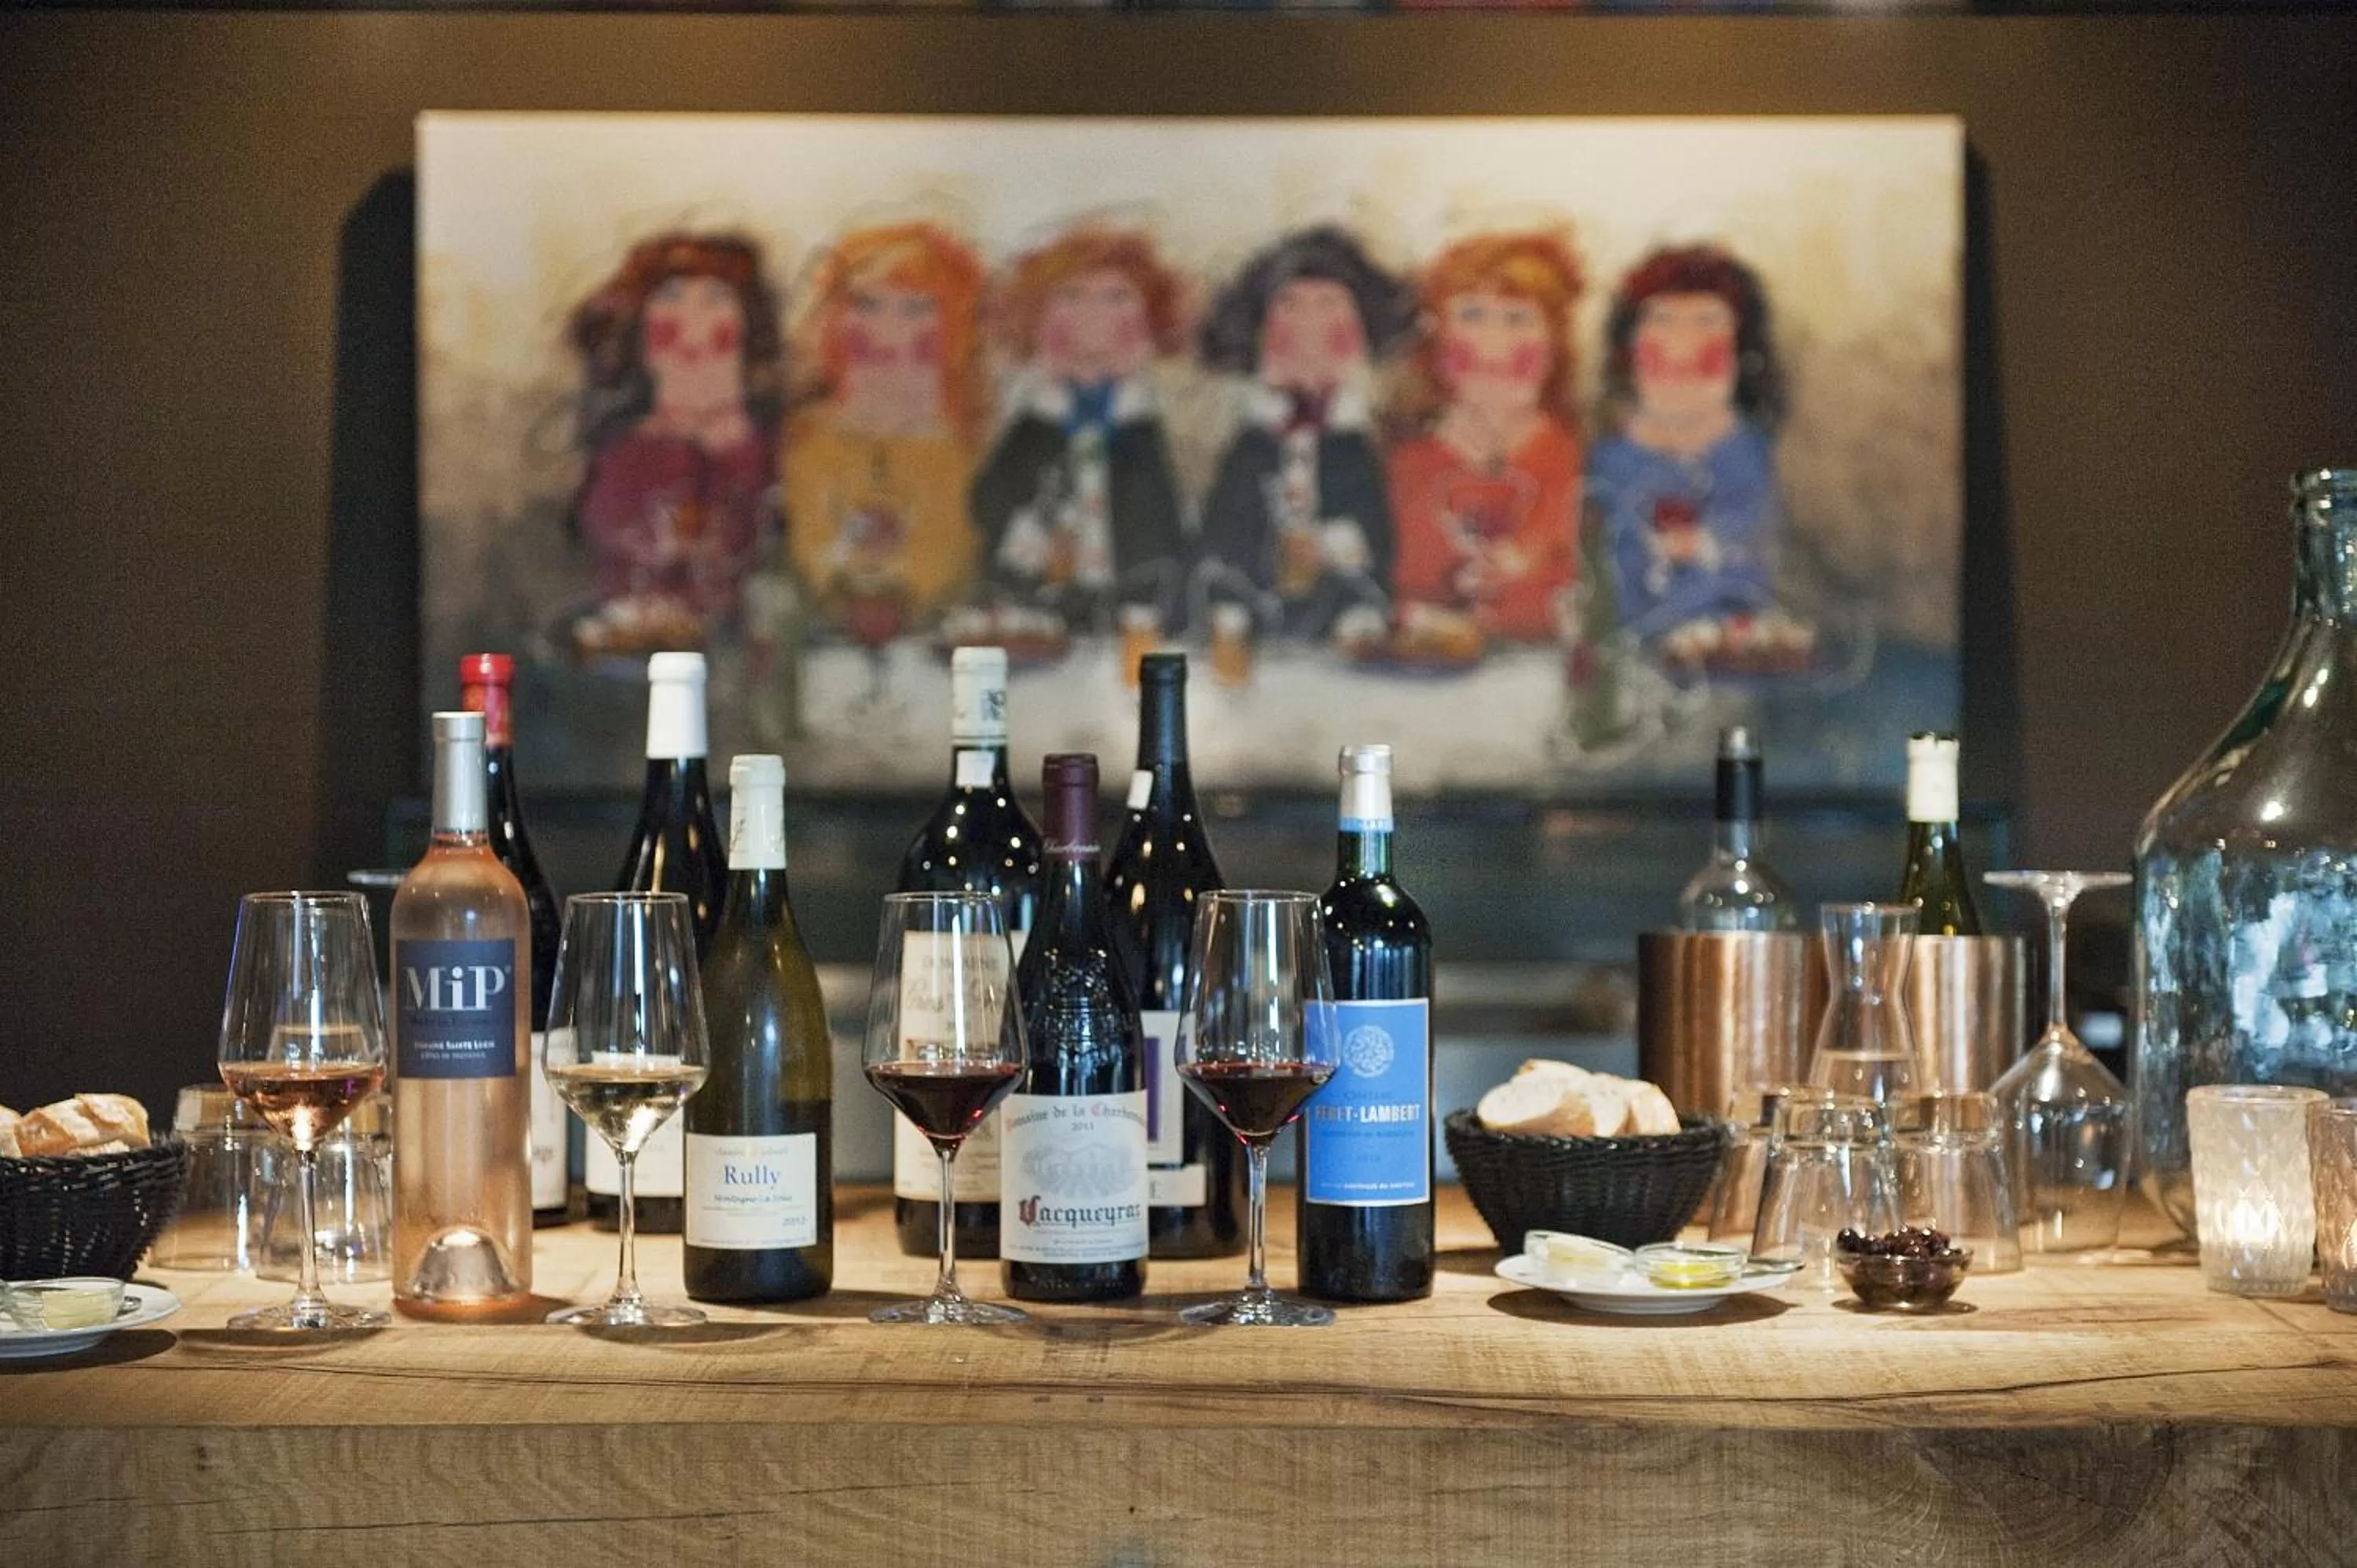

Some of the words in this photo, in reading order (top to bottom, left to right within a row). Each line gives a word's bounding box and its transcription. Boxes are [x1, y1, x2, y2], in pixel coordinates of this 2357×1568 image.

[401, 966, 505, 1011] MiP
[1051, 1105, 1067, 1119] de
[1072, 1103, 1086, 1116] la
[724, 1164, 780, 1190] Rully
